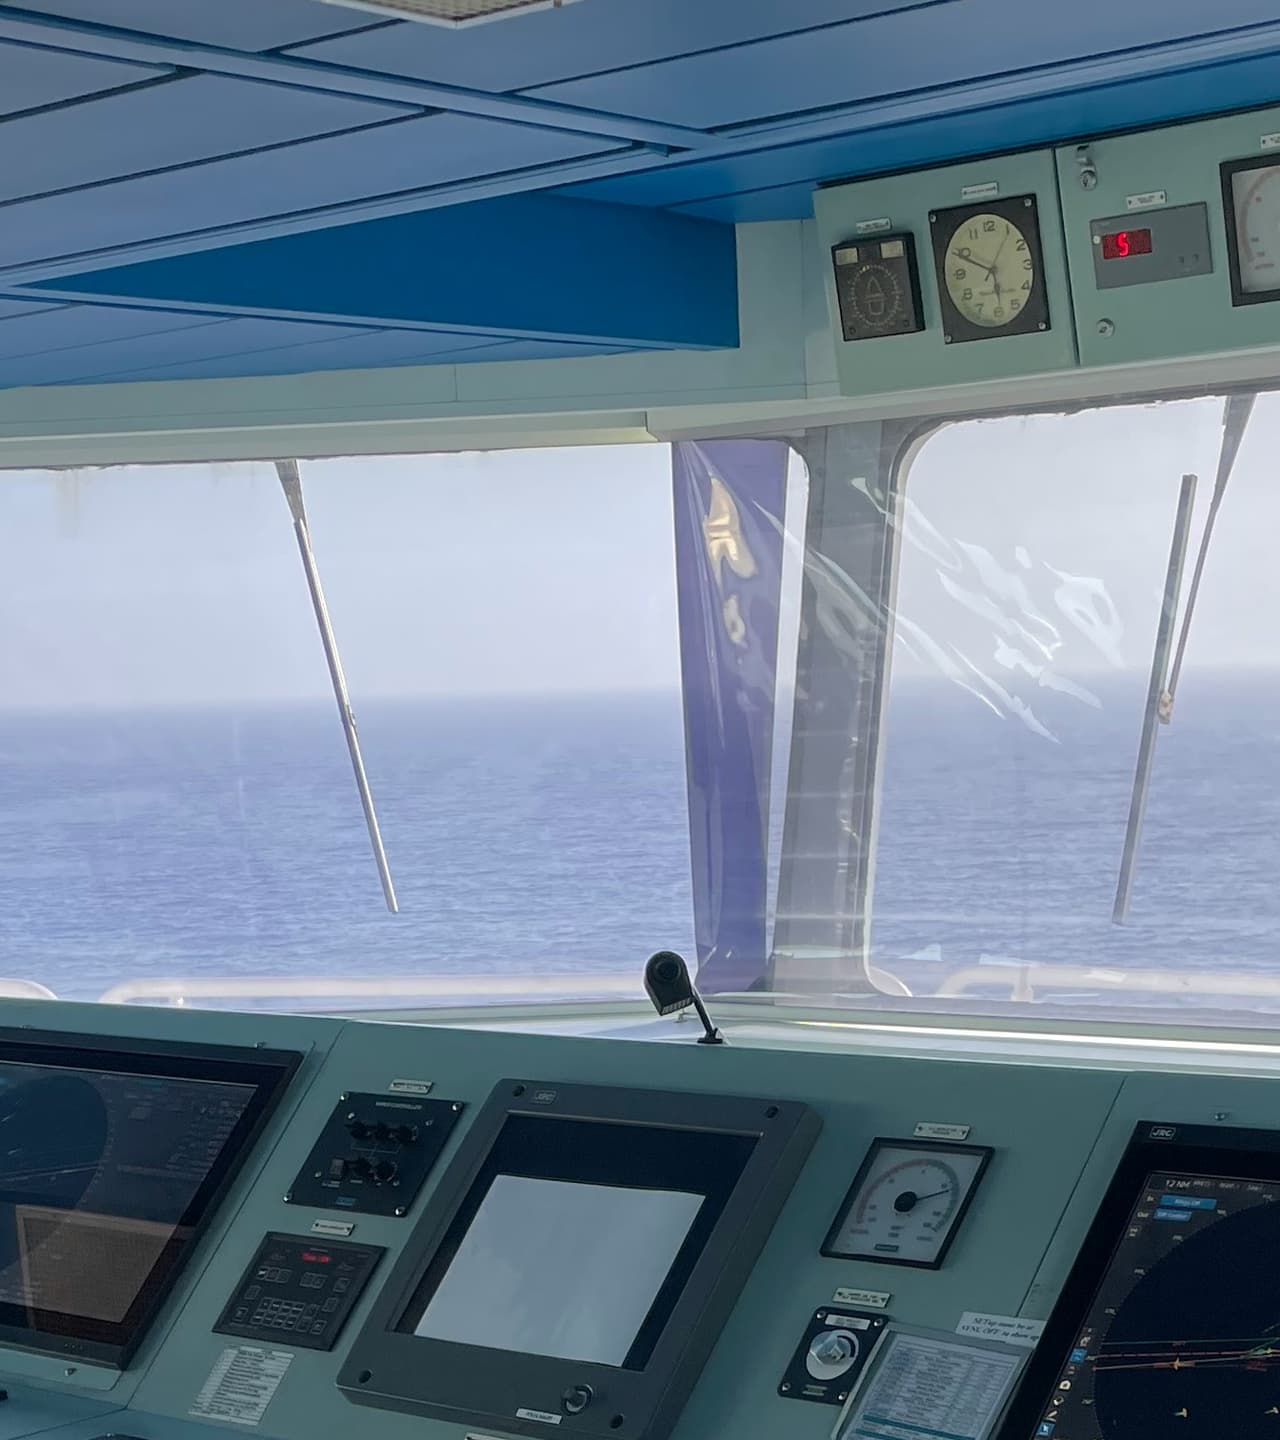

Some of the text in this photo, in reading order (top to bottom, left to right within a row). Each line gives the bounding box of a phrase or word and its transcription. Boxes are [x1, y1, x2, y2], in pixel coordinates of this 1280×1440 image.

[983, 220, 996, 232] 12
[969, 228, 978, 240] 11
[1016, 239, 1026, 251] 2
[1023, 259, 1033, 271] 3
[955, 268, 967, 280] 9
[1021, 279, 1031, 291] 4
[963, 288, 973, 301] 8
[975, 303, 985, 314] 7
[1011, 299, 1021, 311] 5
[994, 306, 1005, 318] 6
[1151, 1128, 1174, 1139] JRC
